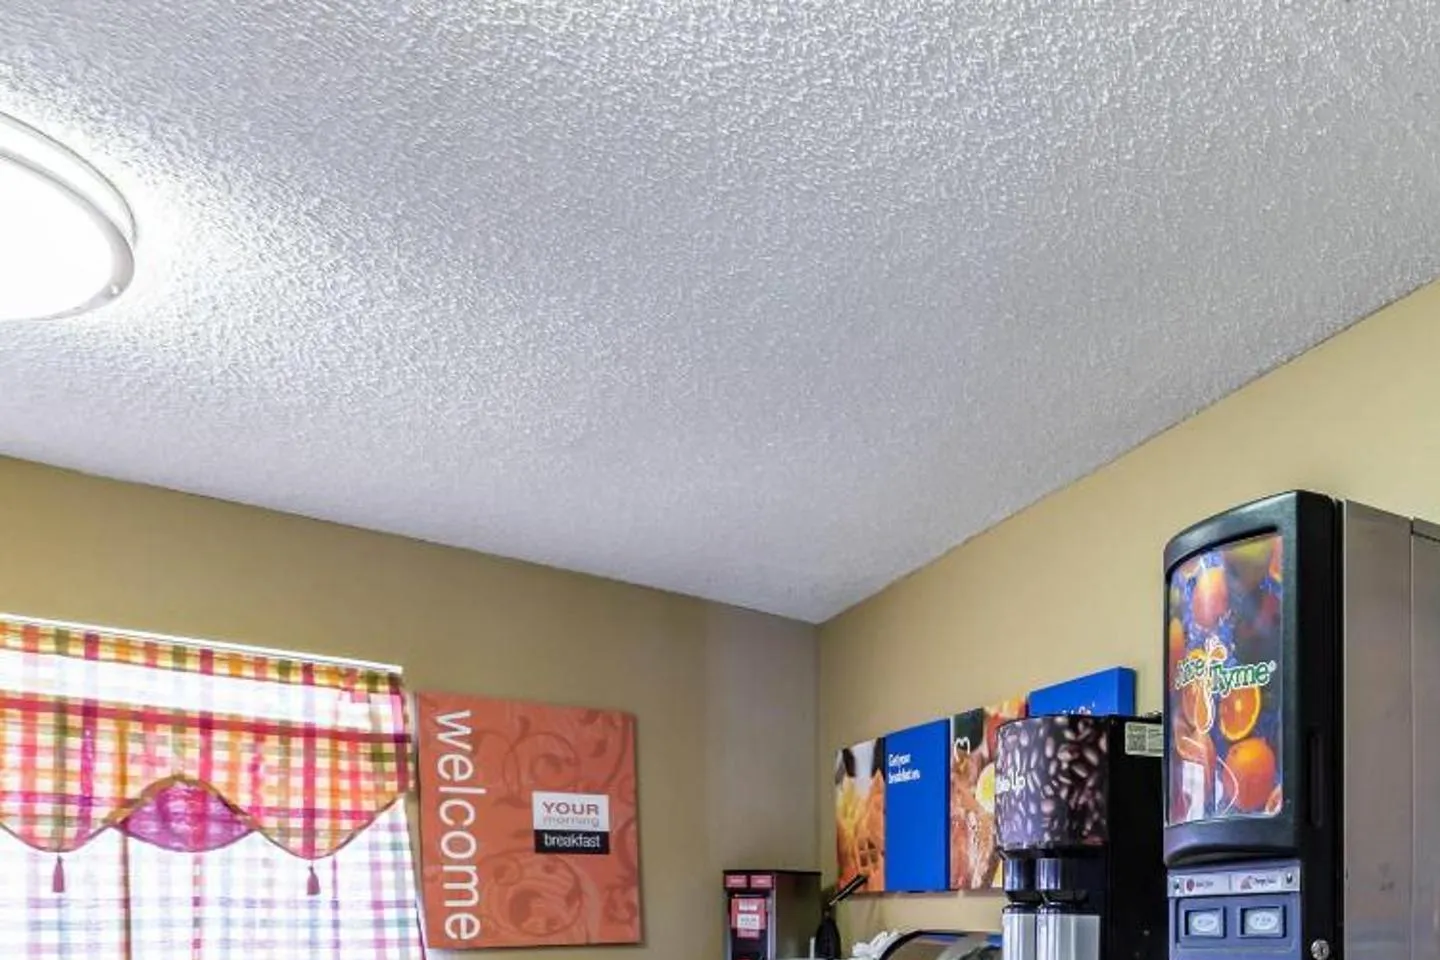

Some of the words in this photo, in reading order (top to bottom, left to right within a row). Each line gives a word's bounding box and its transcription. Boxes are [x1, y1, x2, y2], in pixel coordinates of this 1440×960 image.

[542, 801, 599, 815] YOUR
[434, 709, 487, 940] welcome
[544, 833, 600, 848] breakfast
